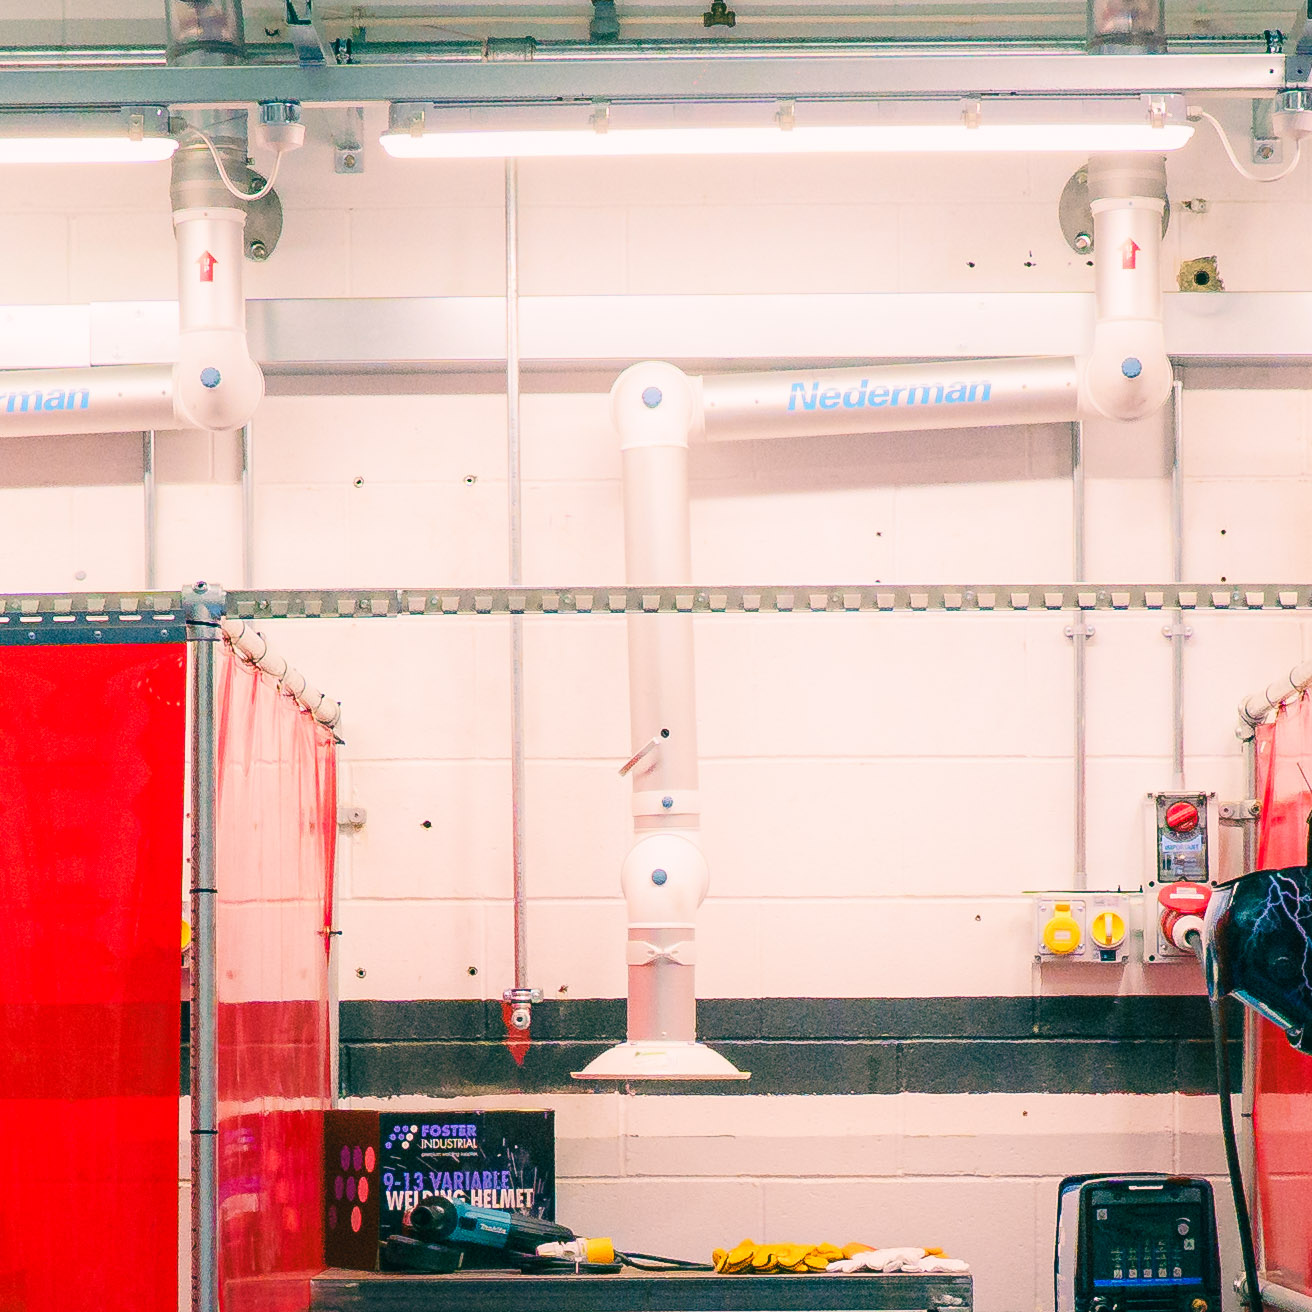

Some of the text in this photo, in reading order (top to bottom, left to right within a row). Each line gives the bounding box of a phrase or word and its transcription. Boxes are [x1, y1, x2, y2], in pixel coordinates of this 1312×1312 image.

[787, 379, 992, 411] Nederman
[421, 1124, 477, 1137] FOSTER
[421, 1138, 478, 1149] INDUSTRIAL
[383, 1170, 510, 1191] 9-13 VARIABLE
[471, 1188, 534, 1209] HELMET
